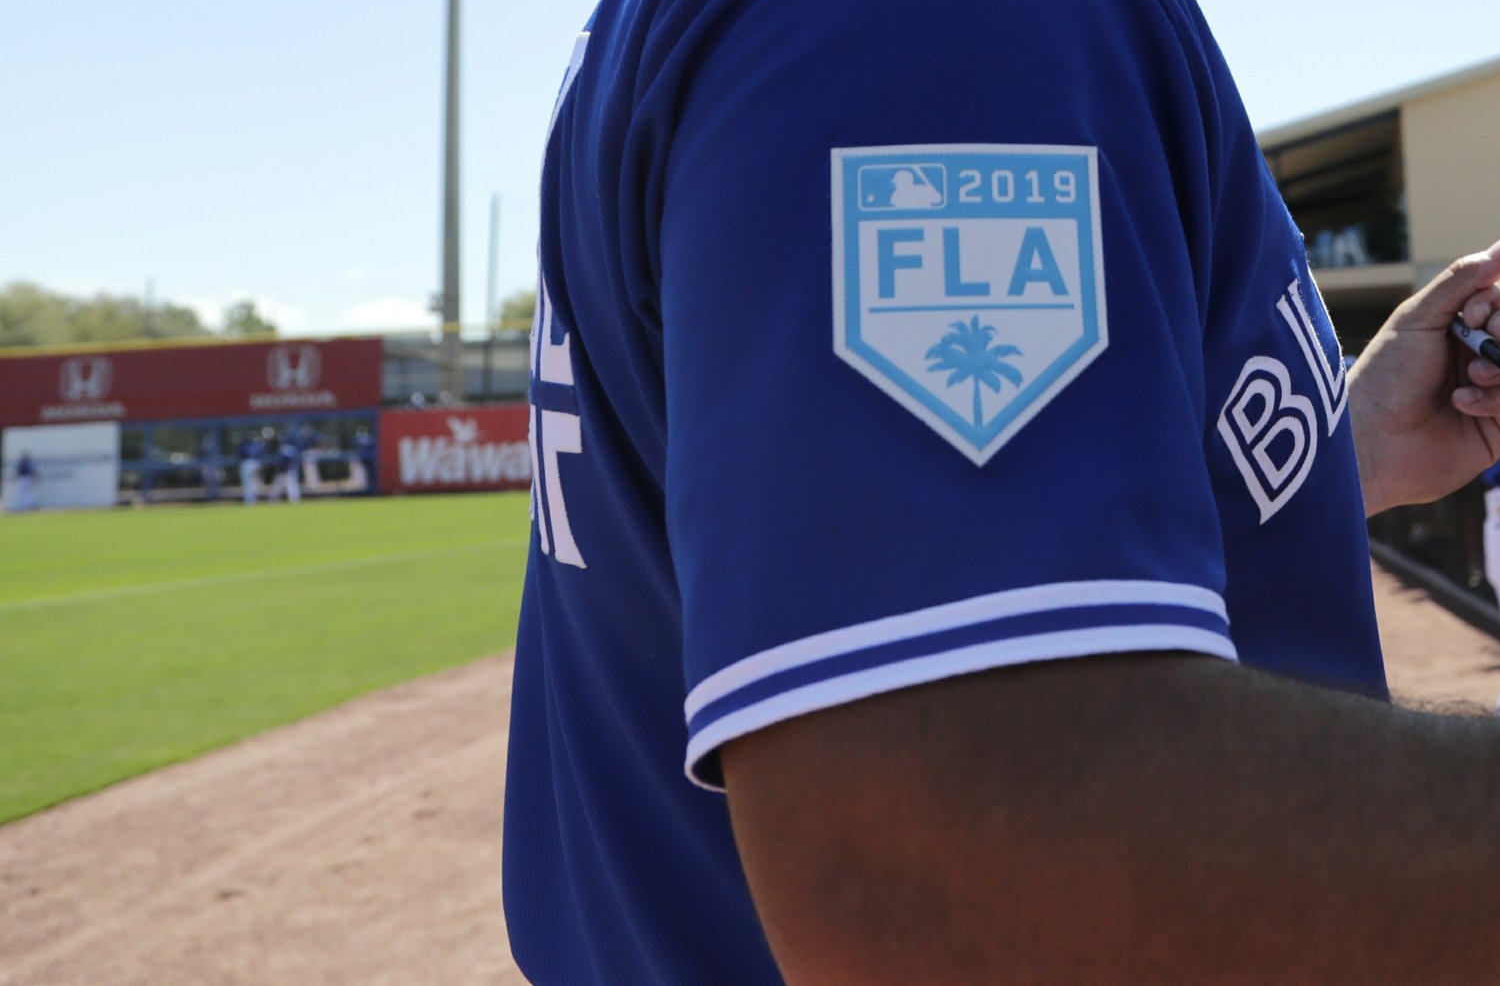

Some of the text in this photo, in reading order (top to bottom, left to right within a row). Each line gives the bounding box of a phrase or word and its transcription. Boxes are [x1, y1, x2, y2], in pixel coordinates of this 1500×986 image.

[958, 169, 1077, 204] 2019
[876, 226, 1070, 300] FLA
[399, 436, 533, 486] Wawa
